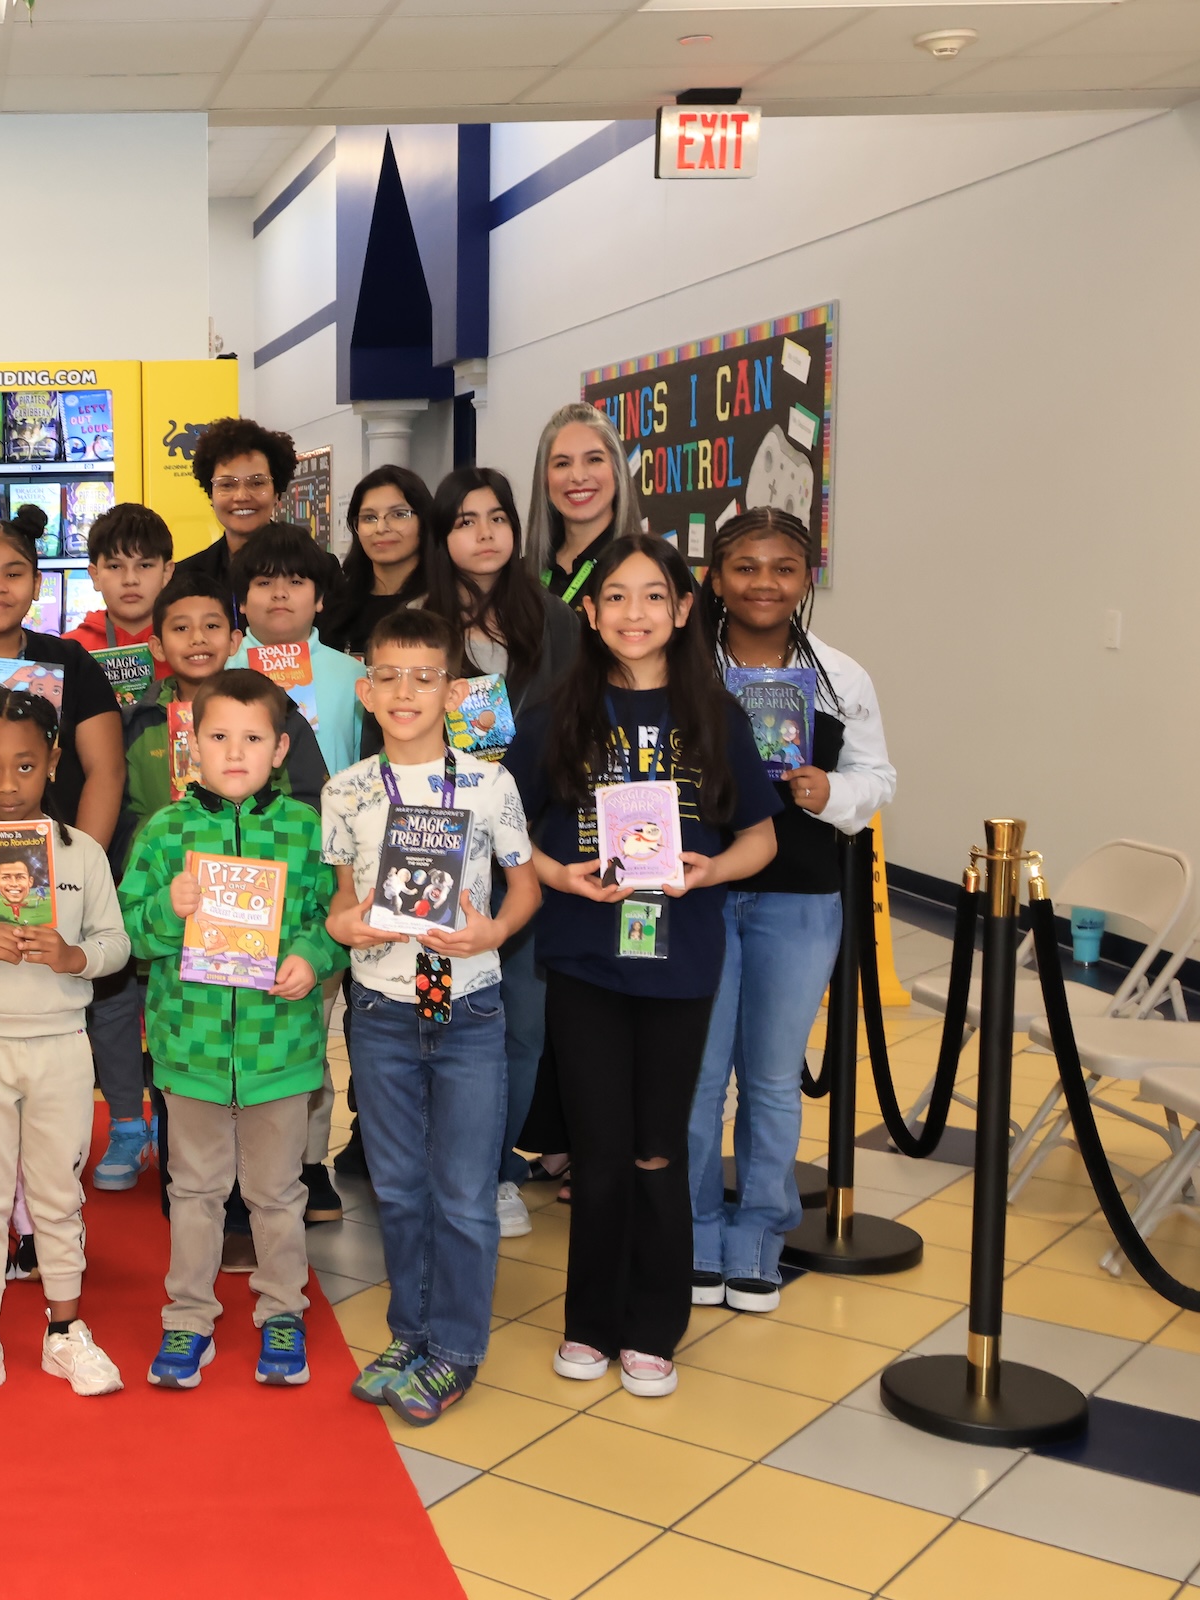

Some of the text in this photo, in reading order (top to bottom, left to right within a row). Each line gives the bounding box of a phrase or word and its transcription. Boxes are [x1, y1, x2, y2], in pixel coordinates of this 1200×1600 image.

[676, 113, 749, 169] EXIT
[690, 374, 698, 428] I
[715, 355, 774, 422] CAN
[18, 395, 47, 404] PIRATES
[14, 408, 51, 419] CARIBBEAN
[78, 404, 106, 415] LETY
[70, 415, 93, 426] OUT
[81, 424, 109, 434] LOUD
[641, 435, 742, 496] CONTROL
[79, 490, 106, 499] PIRATES
[257, 643, 302, 660] ROALD
[105, 655, 139, 670] MAGIC
[262, 657, 300, 672] DAHL
[120, 665, 150, 680] HOUSE
[745, 687, 796, 699] THE NIGHT
[430, 809, 465, 817] OSBORNE'S
[622, 801, 657, 814] PARK
[408, 814, 450, 833] MAGIC
[578, 821, 597, 829] Music
[14, 830, 22, 838] Is
[10, 836, 46, 847] Ronaldo?
[391, 830, 461, 850] TREE HOUSE
[578, 837, 592, 845] Oral
